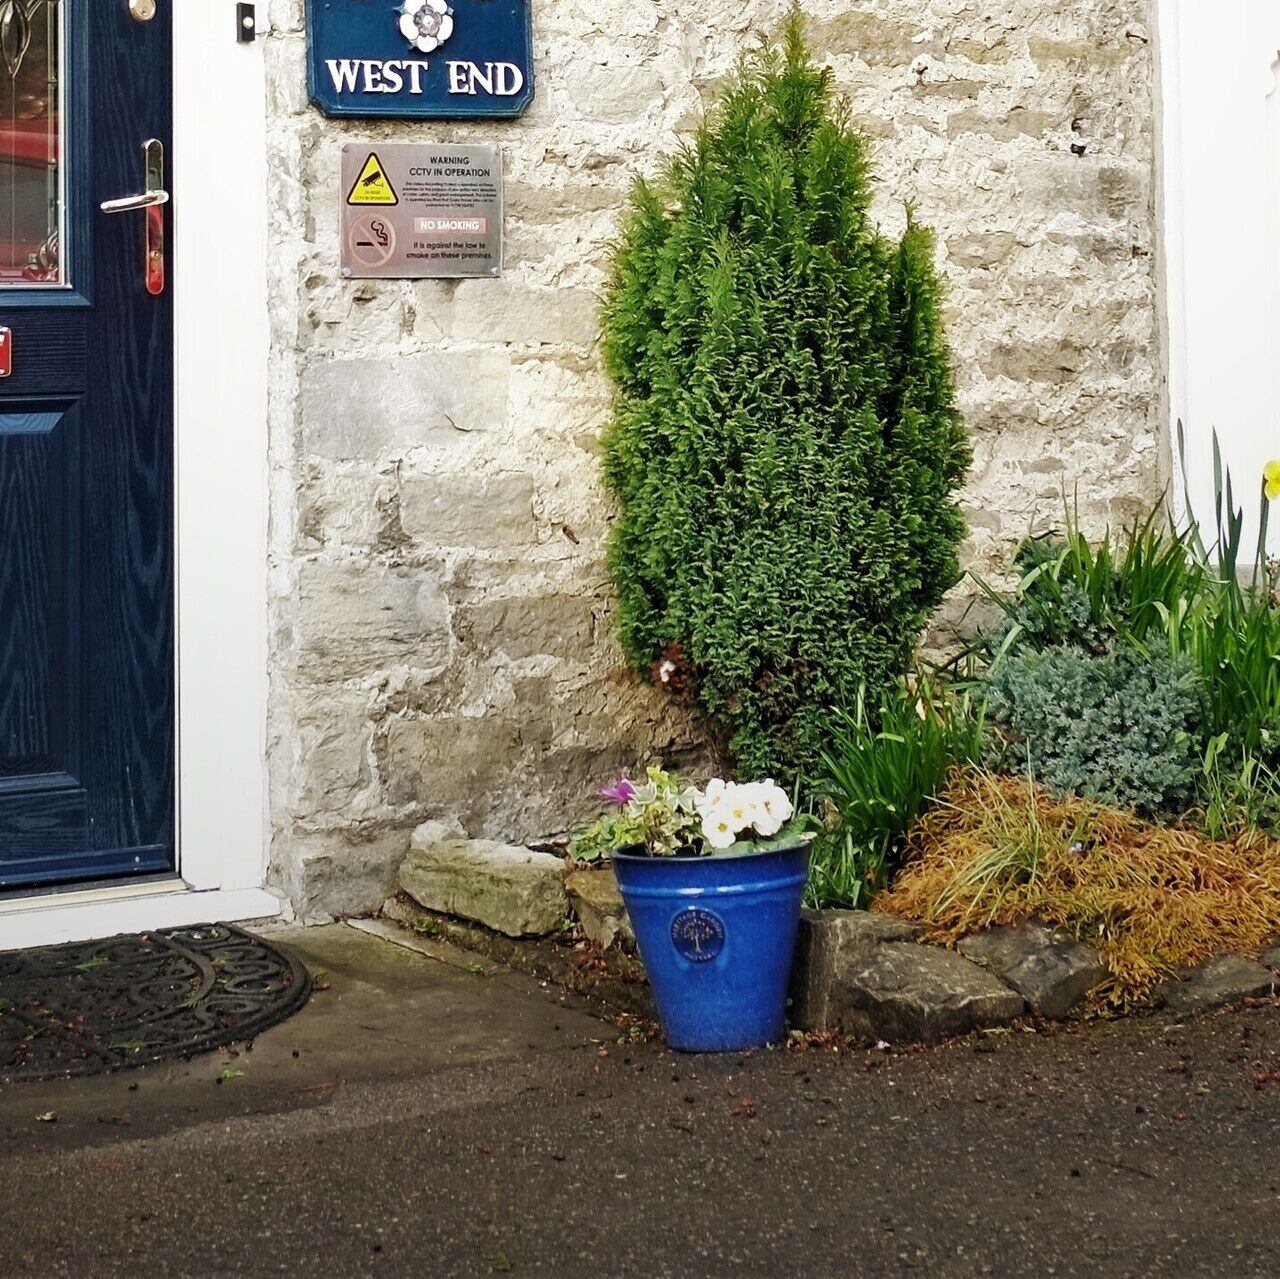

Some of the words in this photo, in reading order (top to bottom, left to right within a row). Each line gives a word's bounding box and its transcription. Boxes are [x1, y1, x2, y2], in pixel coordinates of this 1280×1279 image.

[325, 59, 428, 94] WEST
[446, 61, 523, 96] END
[430, 157, 470, 165] WARNING
[409, 168, 431, 177] CCTV
[433, 168, 443, 176] IN
[444, 168, 490, 177] OPERATION
[420, 220, 435, 230] NO
[437, 220, 480, 230] SMOKING
[426, 242, 452, 250] against
